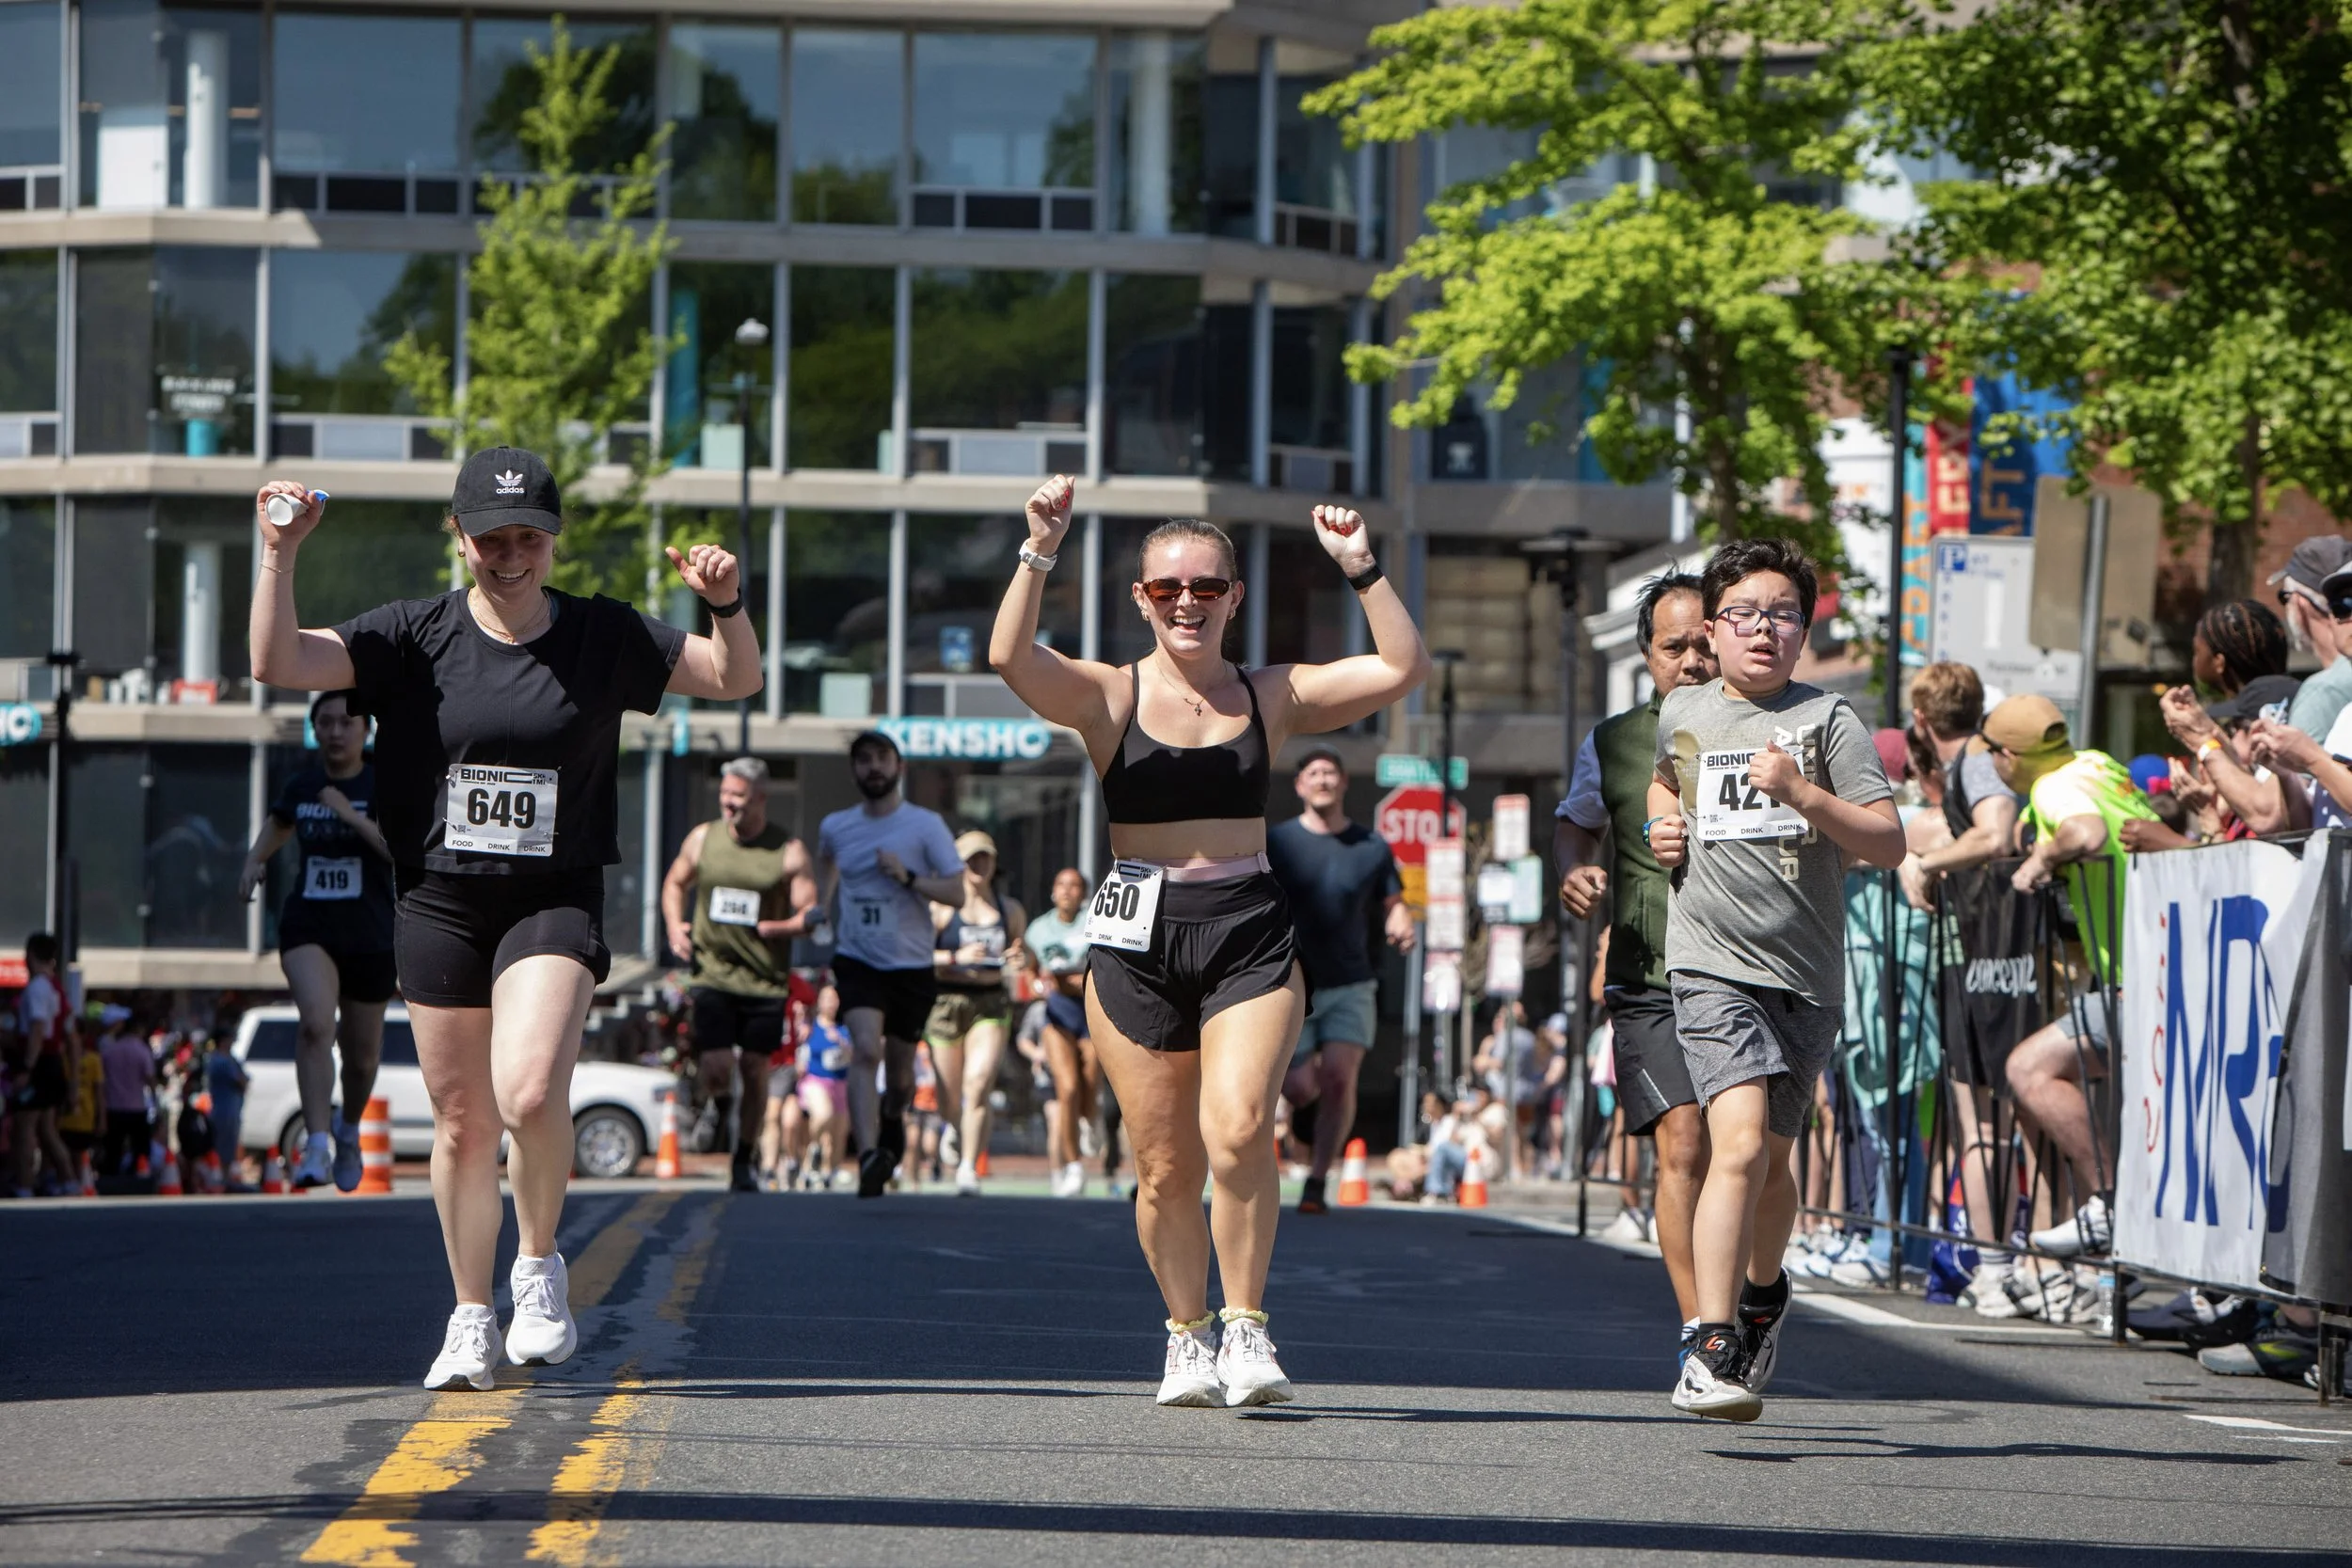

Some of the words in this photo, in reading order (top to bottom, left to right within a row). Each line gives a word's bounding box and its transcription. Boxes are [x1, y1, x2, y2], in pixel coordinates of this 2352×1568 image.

[460, 768, 532, 784] BIONIC
[467, 788, 536, 829] 649
[1777, 823, 1803, 832] DRINK
[452, 839, 474, 847] FOOD
[315, 869, 349, 890] 419
[1094, 880, 1140, 921] 650
[862, 906, 881, 926] 31
[1121, 937, 1143, 946] DRINK
